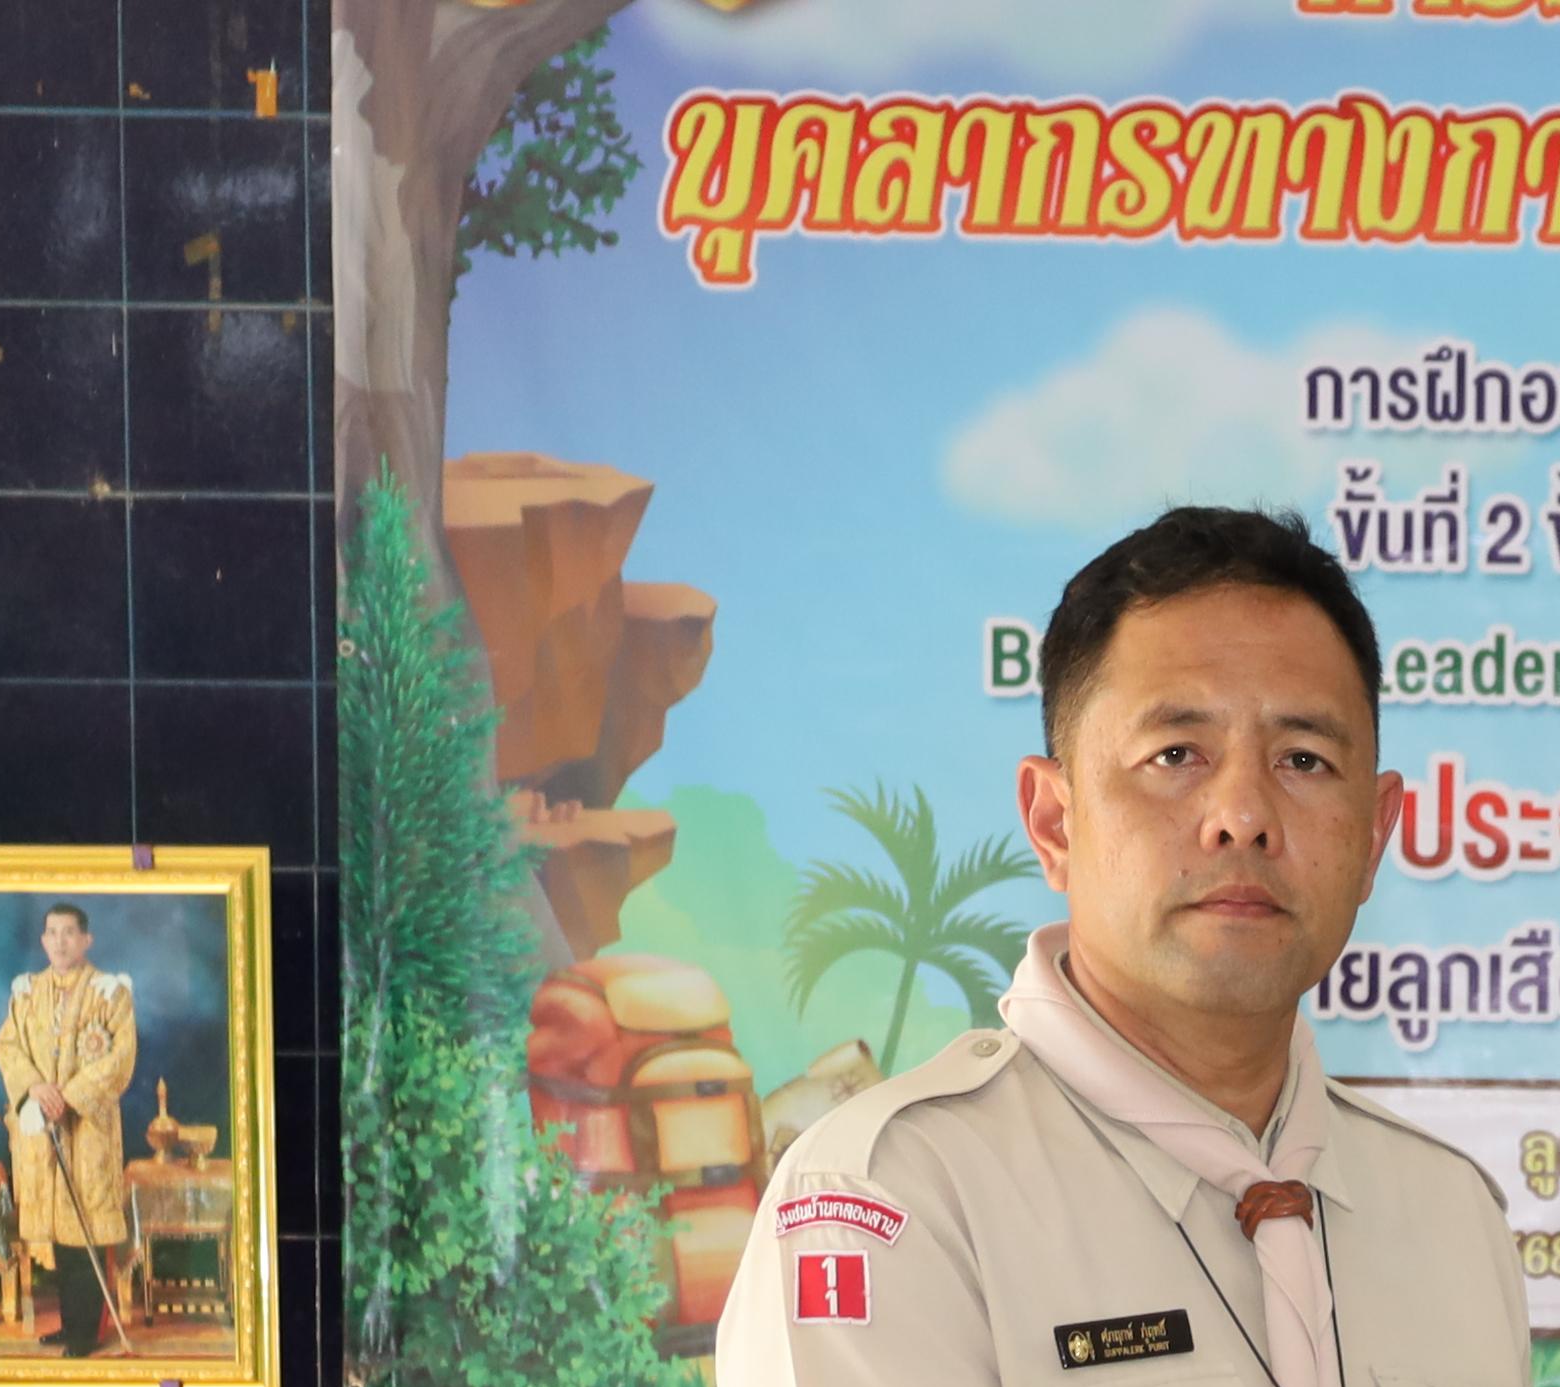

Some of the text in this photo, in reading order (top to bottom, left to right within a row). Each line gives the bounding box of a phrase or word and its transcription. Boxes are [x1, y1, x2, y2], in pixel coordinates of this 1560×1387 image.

[1336, 466, 1461, 566] ขั้นที่
[1486, 502, 1523, 566] 2
[821, 1255, 838, 1289] 1
